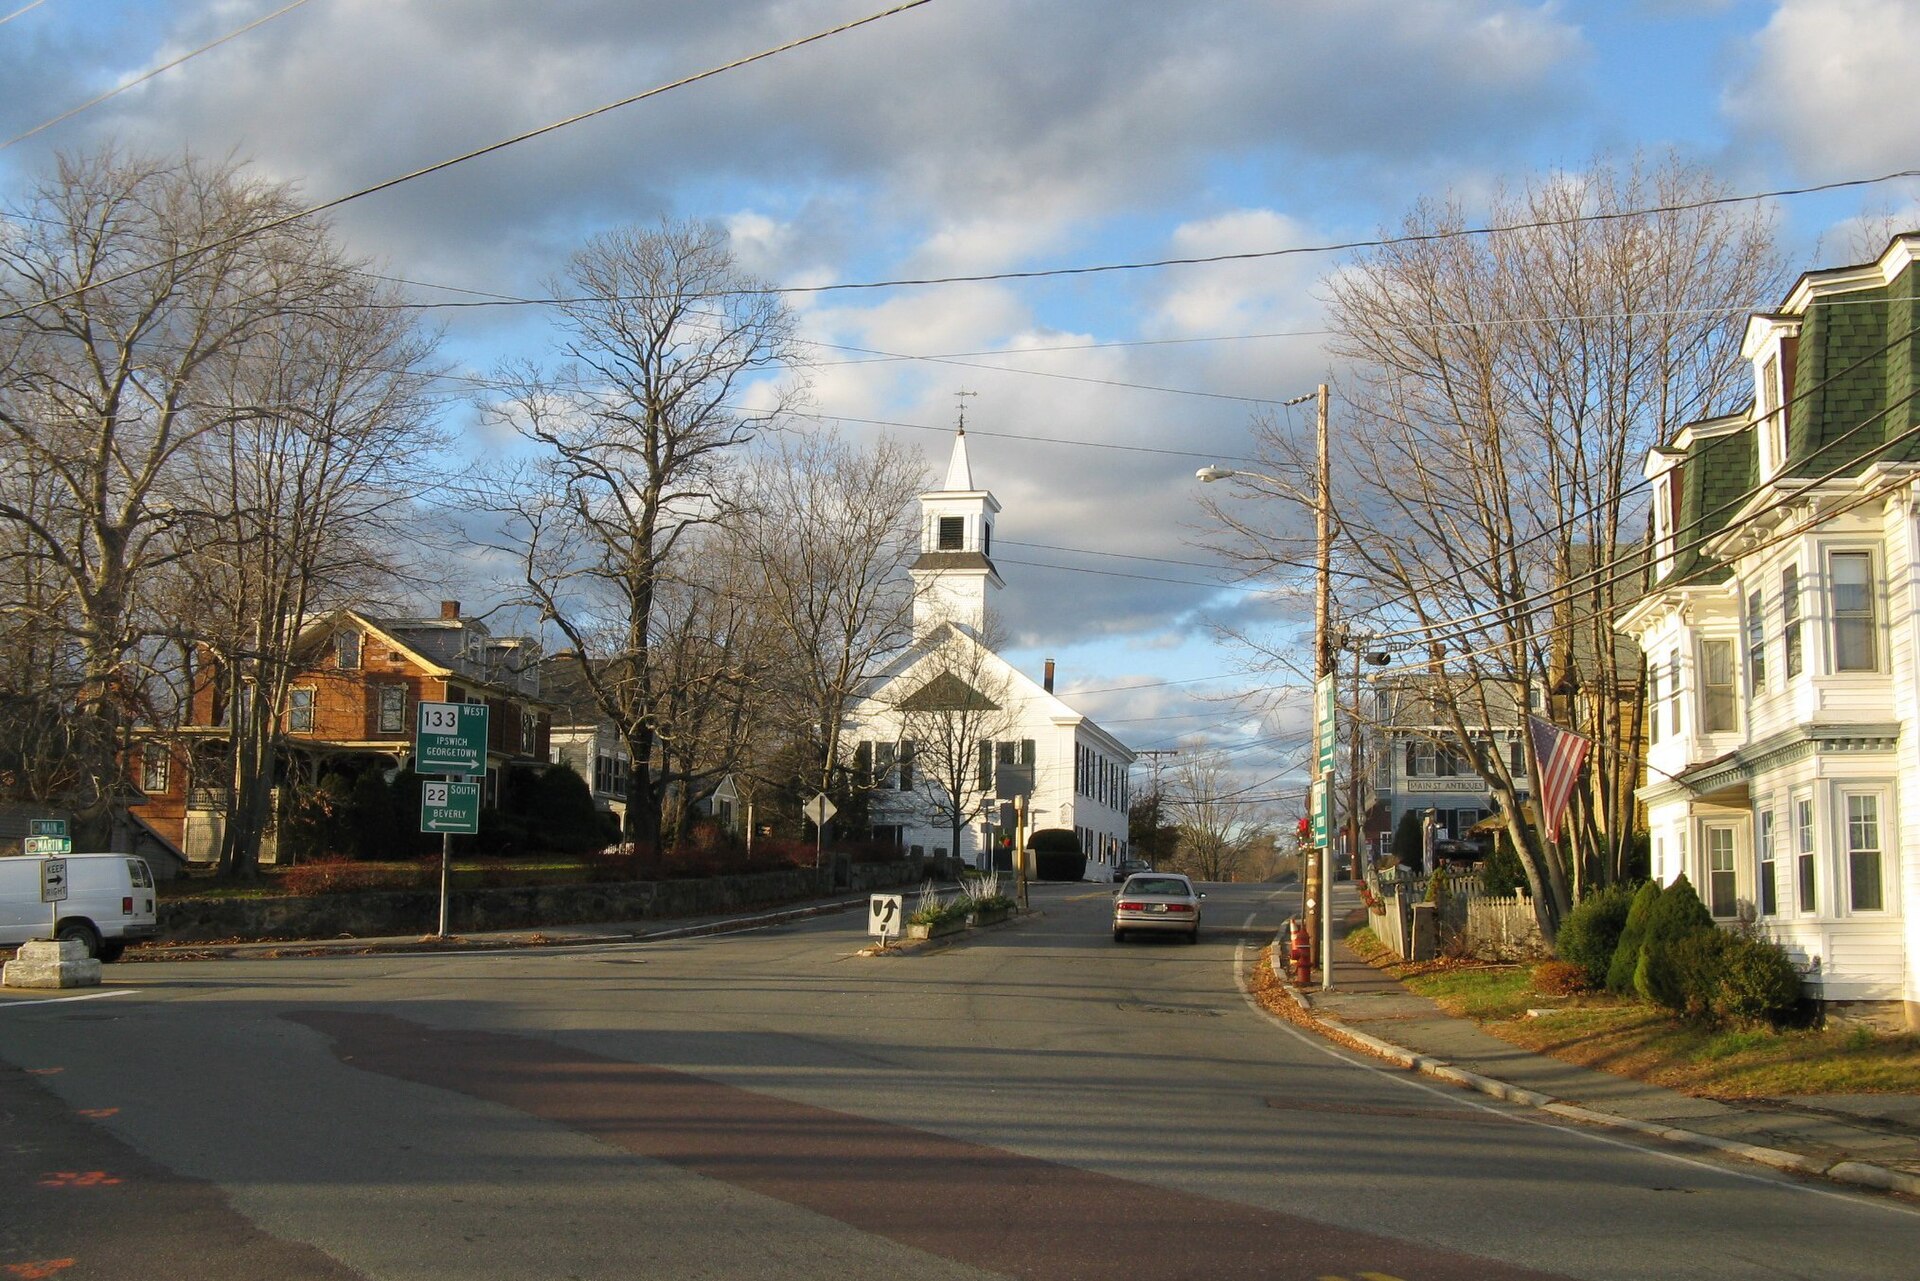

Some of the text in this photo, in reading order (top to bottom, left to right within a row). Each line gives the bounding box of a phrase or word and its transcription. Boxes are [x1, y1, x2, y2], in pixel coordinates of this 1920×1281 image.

[463, 705, 484, 717] WEST
[424, 711, 456, 728] 133
[436, 736, 468, 747] IPSWICH
[426, 747, 477, 758] GEORGETOWN
[451, 784, 476, 795] SOUTH
[427, 789, 446, 802] 22
[433, 809, 467, 819] BEVERLY
[41, 822, 58, 834] MAIN
[37, 839, 63, 851] MARTIN
[47, 864, 64, 874] KEEP
[46, 886, 66, 897] RIGHT
